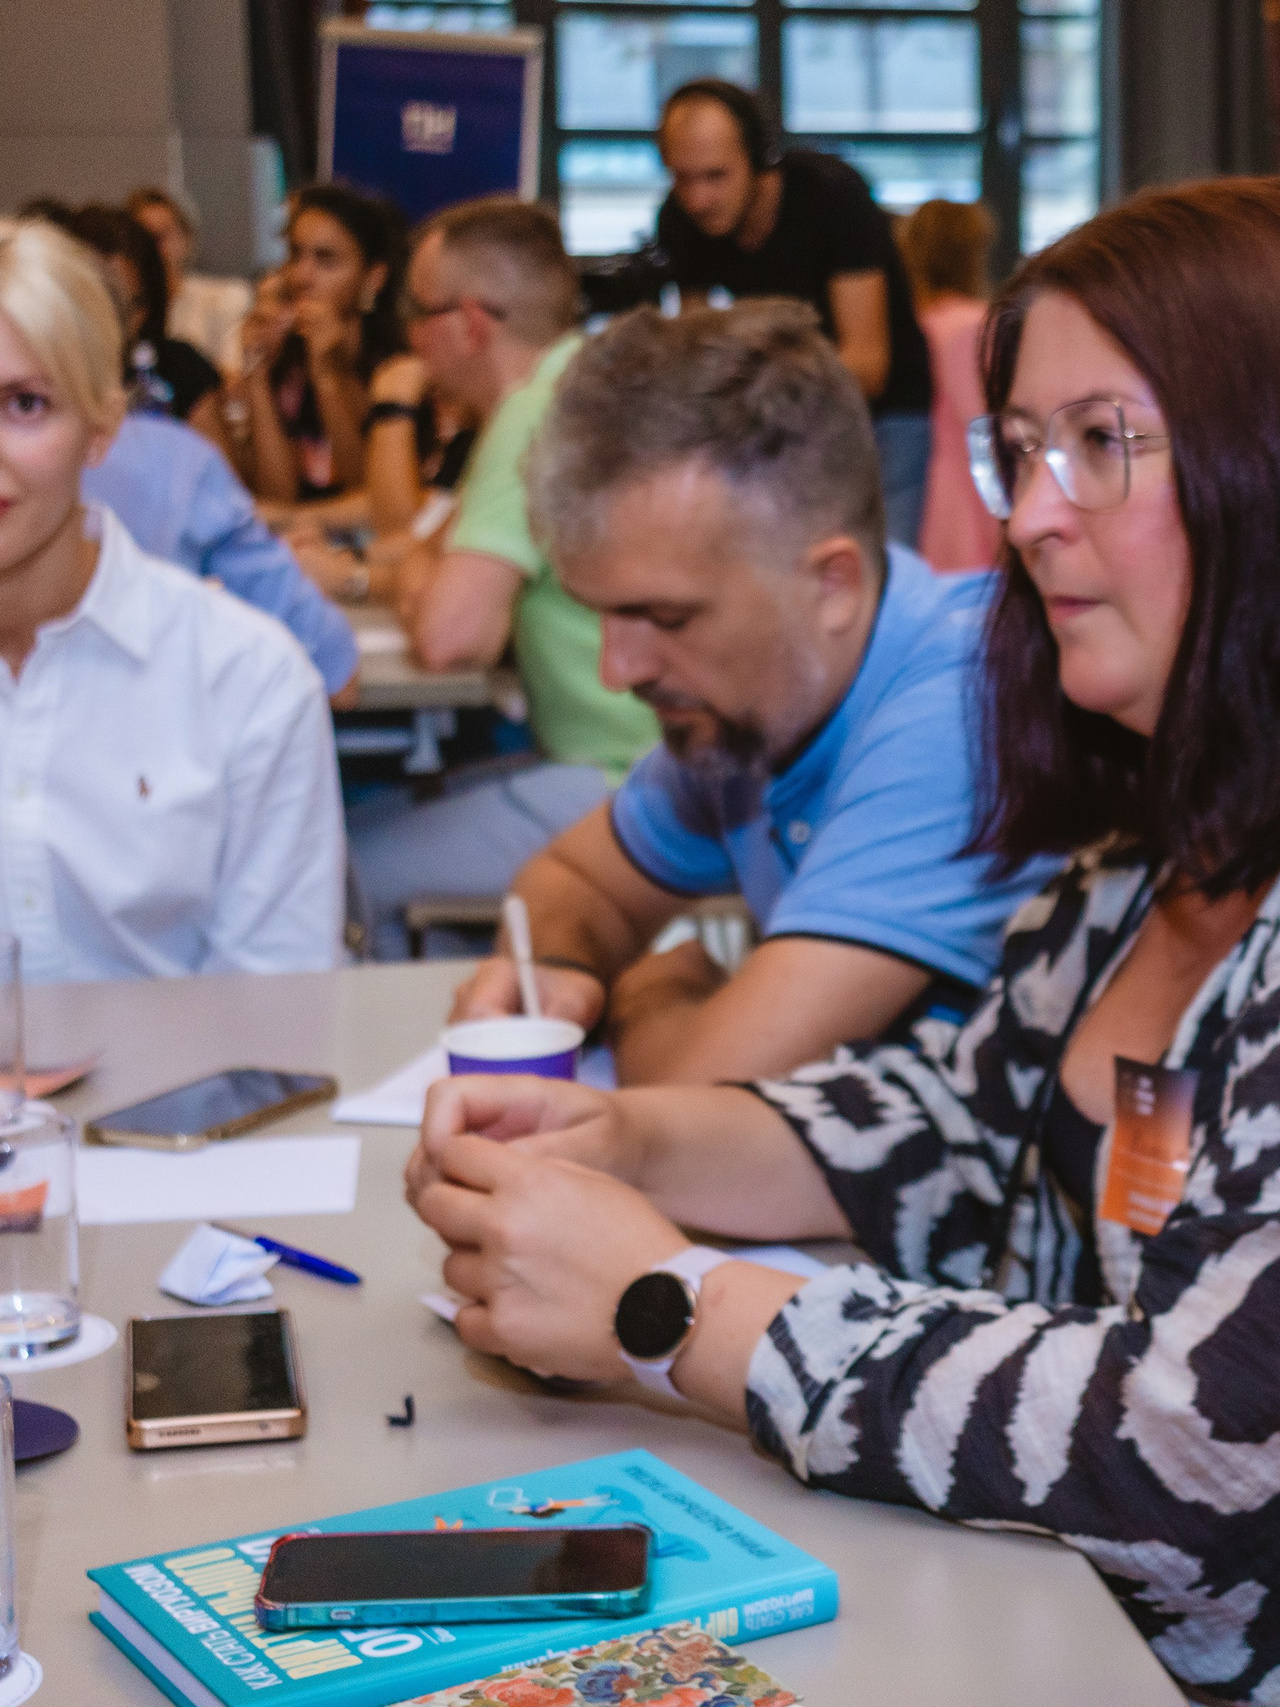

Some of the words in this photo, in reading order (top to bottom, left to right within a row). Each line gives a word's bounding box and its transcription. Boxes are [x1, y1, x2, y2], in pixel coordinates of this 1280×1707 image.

[122, 1563, 221, 1635] ВИРТУОЗОМ
[201, 1629, 256, 1667] СТАТЬ
[231, 1661, 283, 1690] КАК
